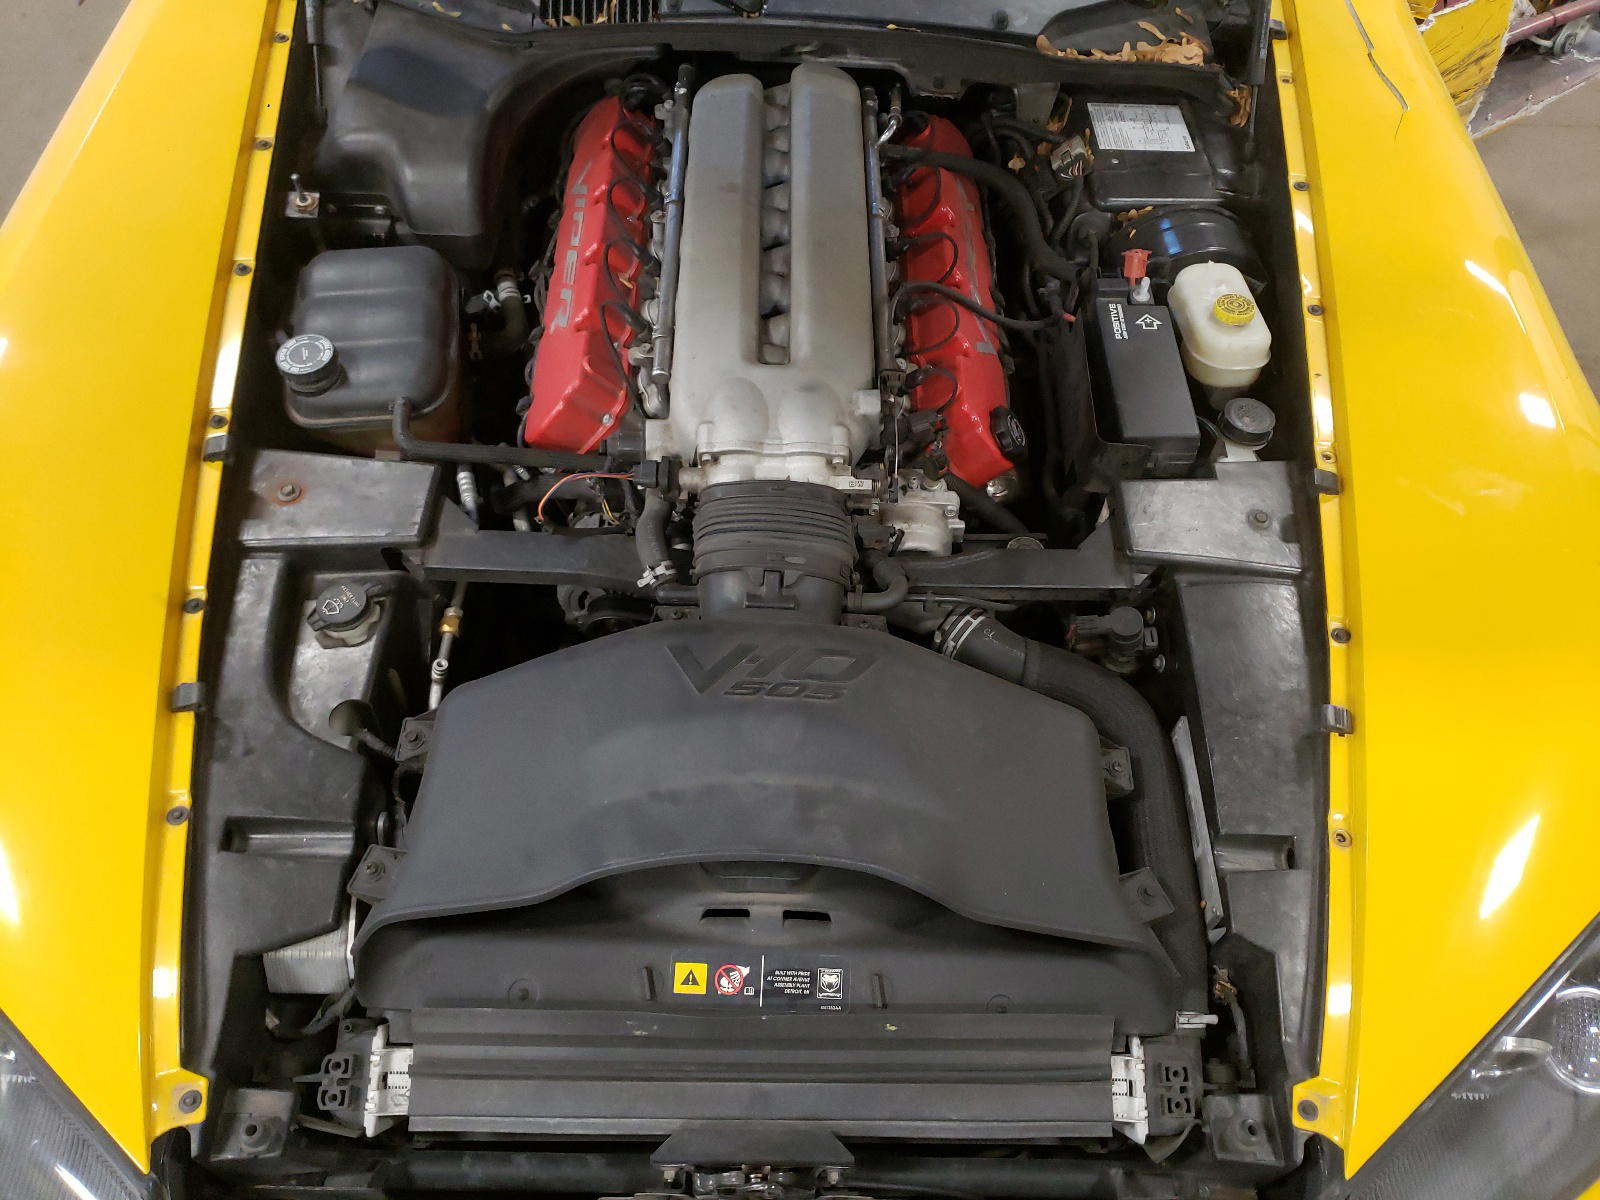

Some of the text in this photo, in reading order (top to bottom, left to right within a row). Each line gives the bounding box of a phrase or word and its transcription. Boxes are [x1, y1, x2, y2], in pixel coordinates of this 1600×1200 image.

[550, 159, 593, 335] VIPER
[1108, 303, 1122, 340] POSITIVE
[723, 680, 849, 700] 505
